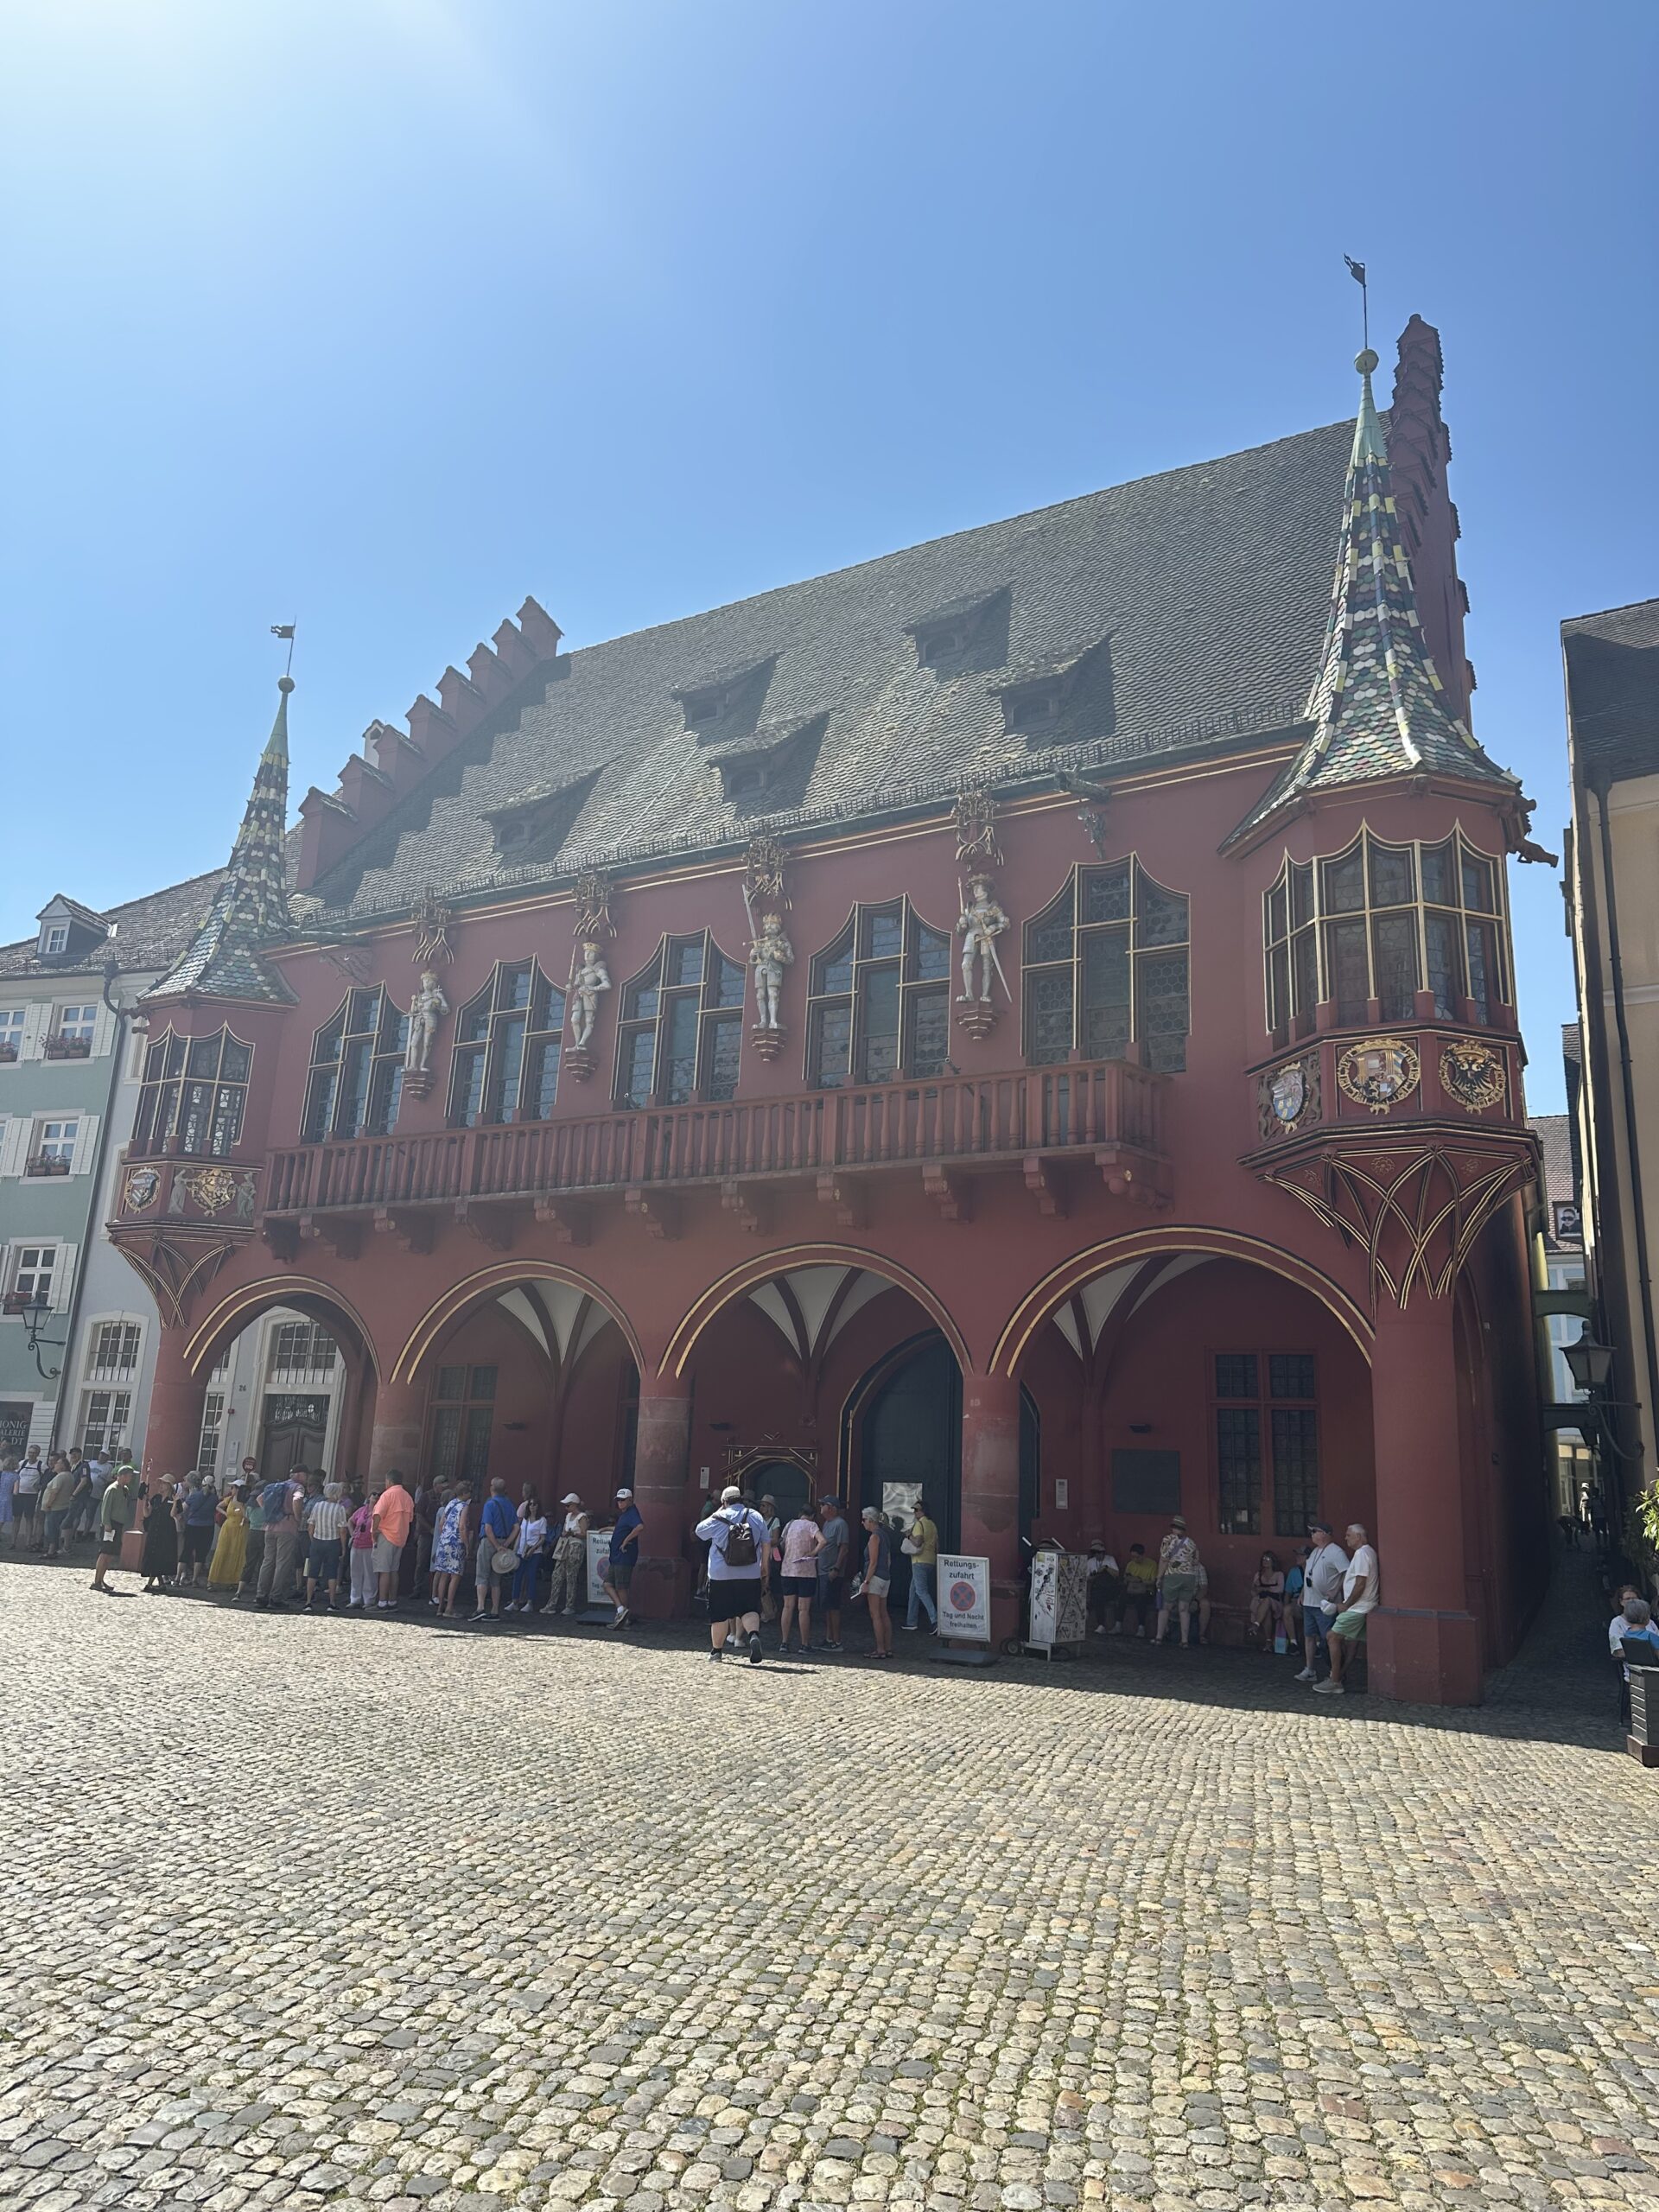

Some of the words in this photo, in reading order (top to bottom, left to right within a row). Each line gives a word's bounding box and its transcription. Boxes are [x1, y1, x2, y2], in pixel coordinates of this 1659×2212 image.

[0, 1420, 27, 1429] ONIG
[944, 1559, 979, 1569] Rettungs-
[949, 1571, 975, 1580] zufahrt
[943, 1611, 953, 1619] Tag
[967, 1612, 984, 1621] Nacht
